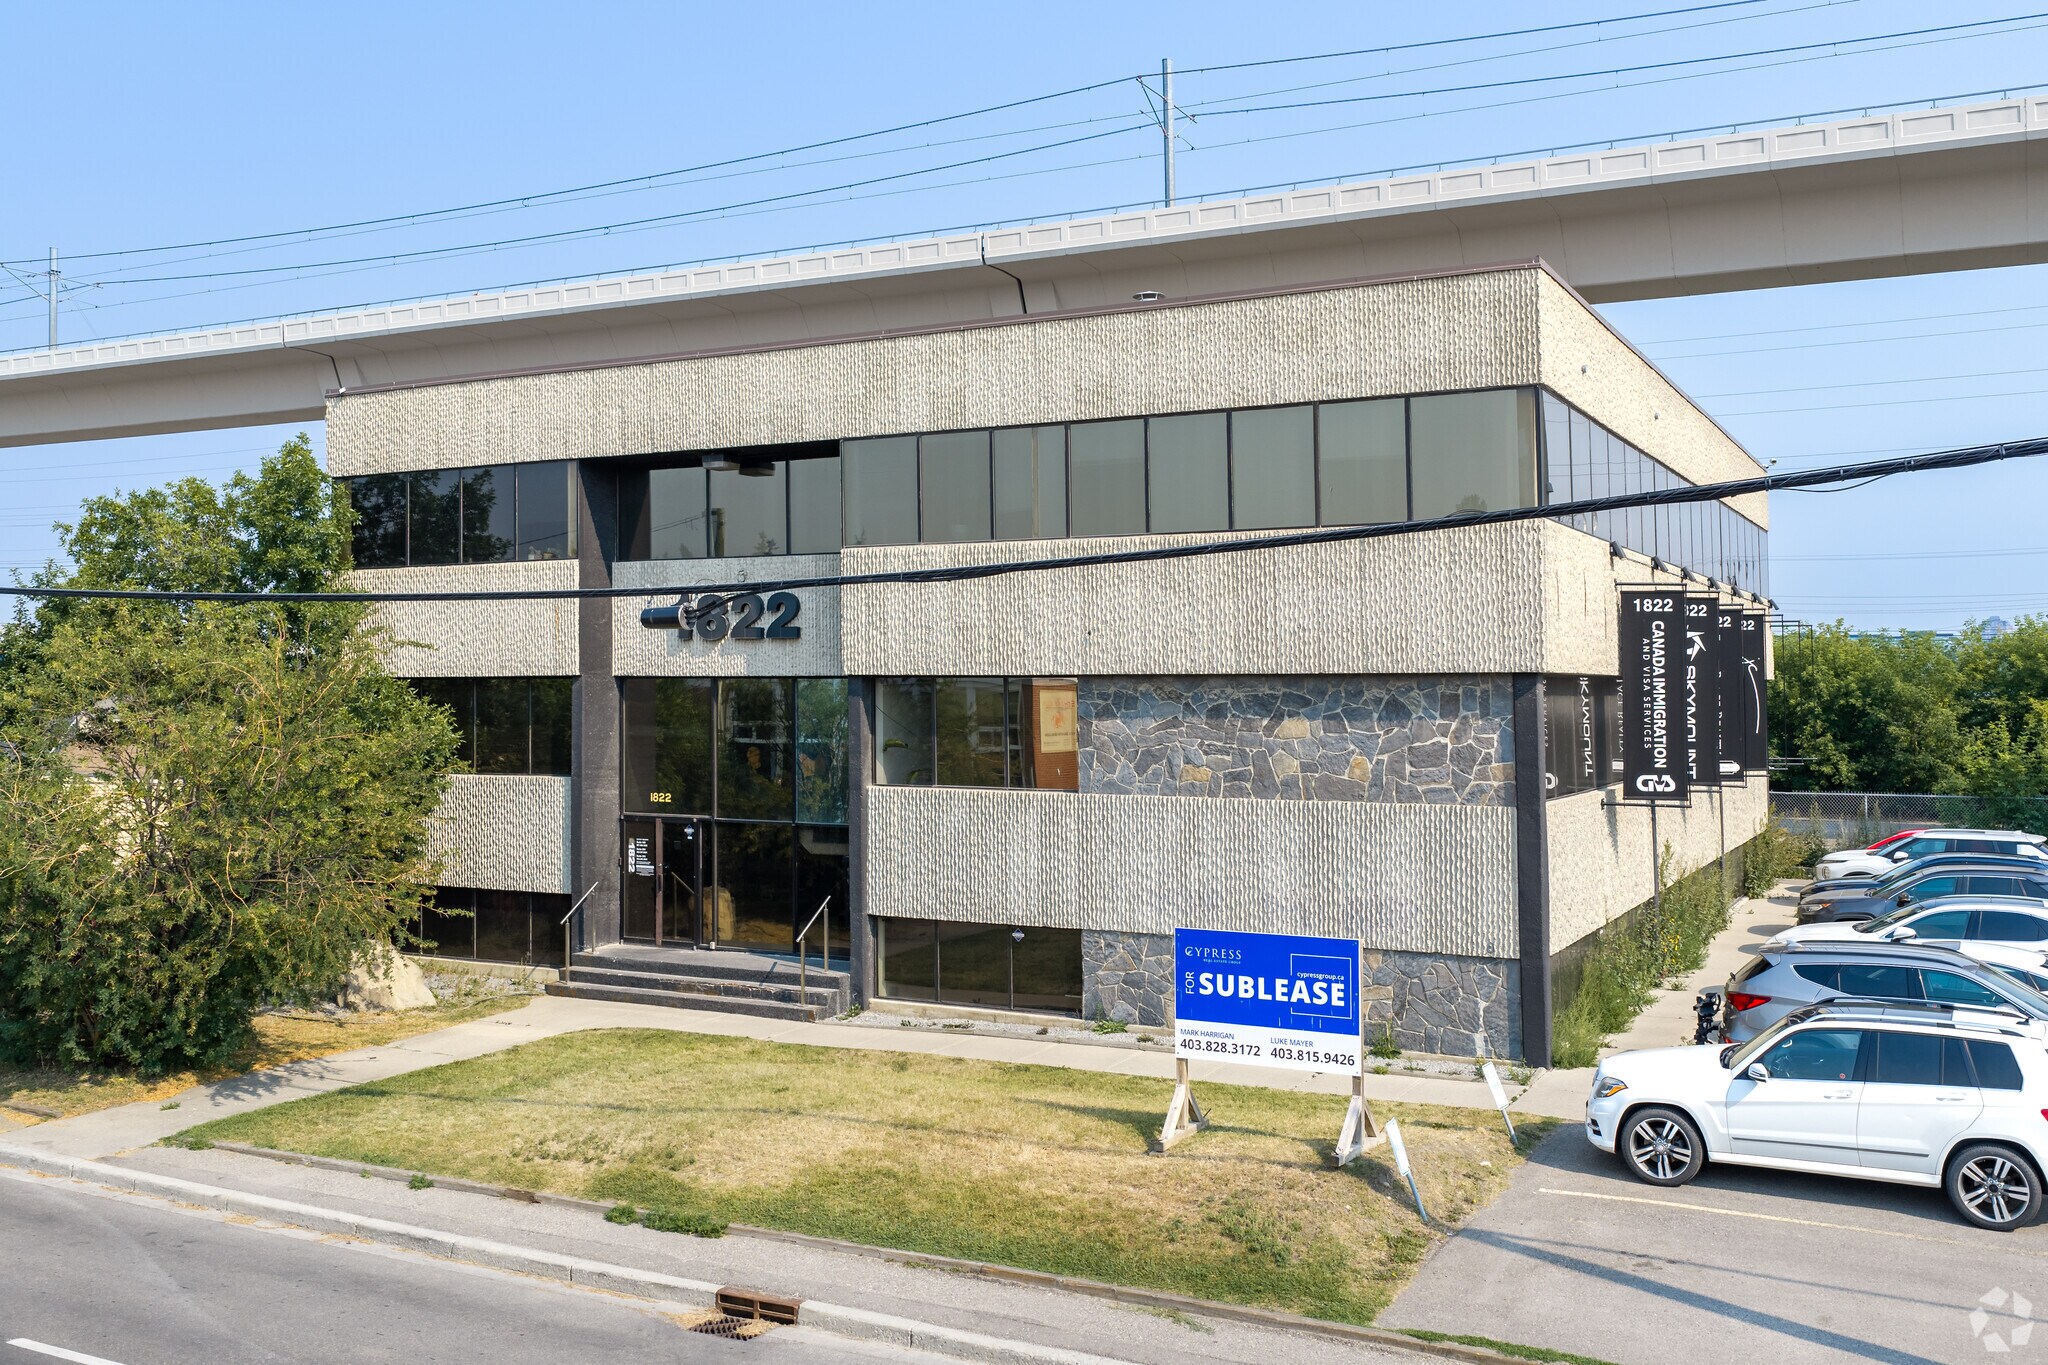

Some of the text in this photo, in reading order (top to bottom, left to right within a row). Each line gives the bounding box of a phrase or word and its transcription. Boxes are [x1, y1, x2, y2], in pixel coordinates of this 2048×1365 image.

[1633, 598, 1673, 612] 1822
[1642, 638, 1652, 749] AND VISA SERVICES
[1652, 620, 1667, 768] CANADA IMMIGRATION
[650, 792, 672, 803] 1822
[628, 843, 636, 873] 1822
[1184, 946, 1242, 960] CYPRESS
[1296, 972, 1345, 981] cypressgroup.ca
[1185, 971, 1345, 1007] FOR SUBLEASE
[1180, 1028, 1235, 1040] MARK HARRIGAN
[1270, 1037, 1314, 1047] LUKE MAYER
[1180, 1038, 1261, 1057] 403.828.3172
[1270, 1047, 1355, 1066] 403.815.9426
